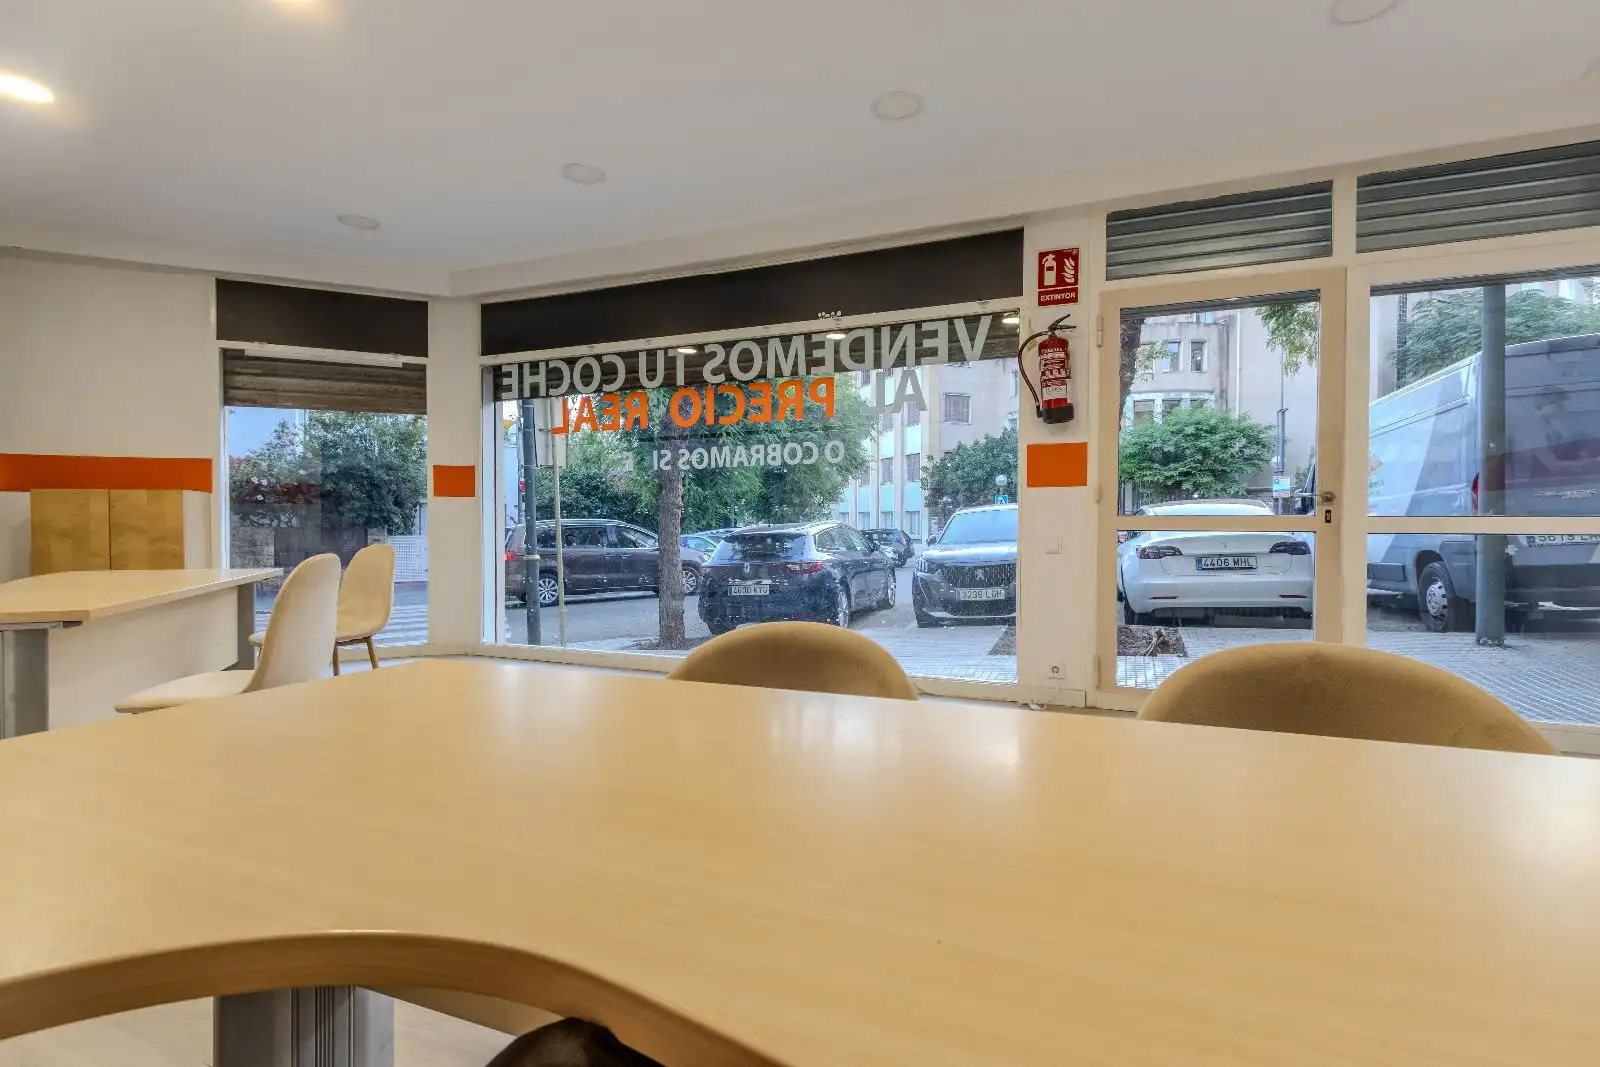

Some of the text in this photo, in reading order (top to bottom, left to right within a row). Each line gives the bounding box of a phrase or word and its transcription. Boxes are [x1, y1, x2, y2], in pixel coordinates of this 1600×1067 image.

[1040, 292, 1076, 302] EXTINTOR
[1203, 557, 1253, 567] 4406 MHL
